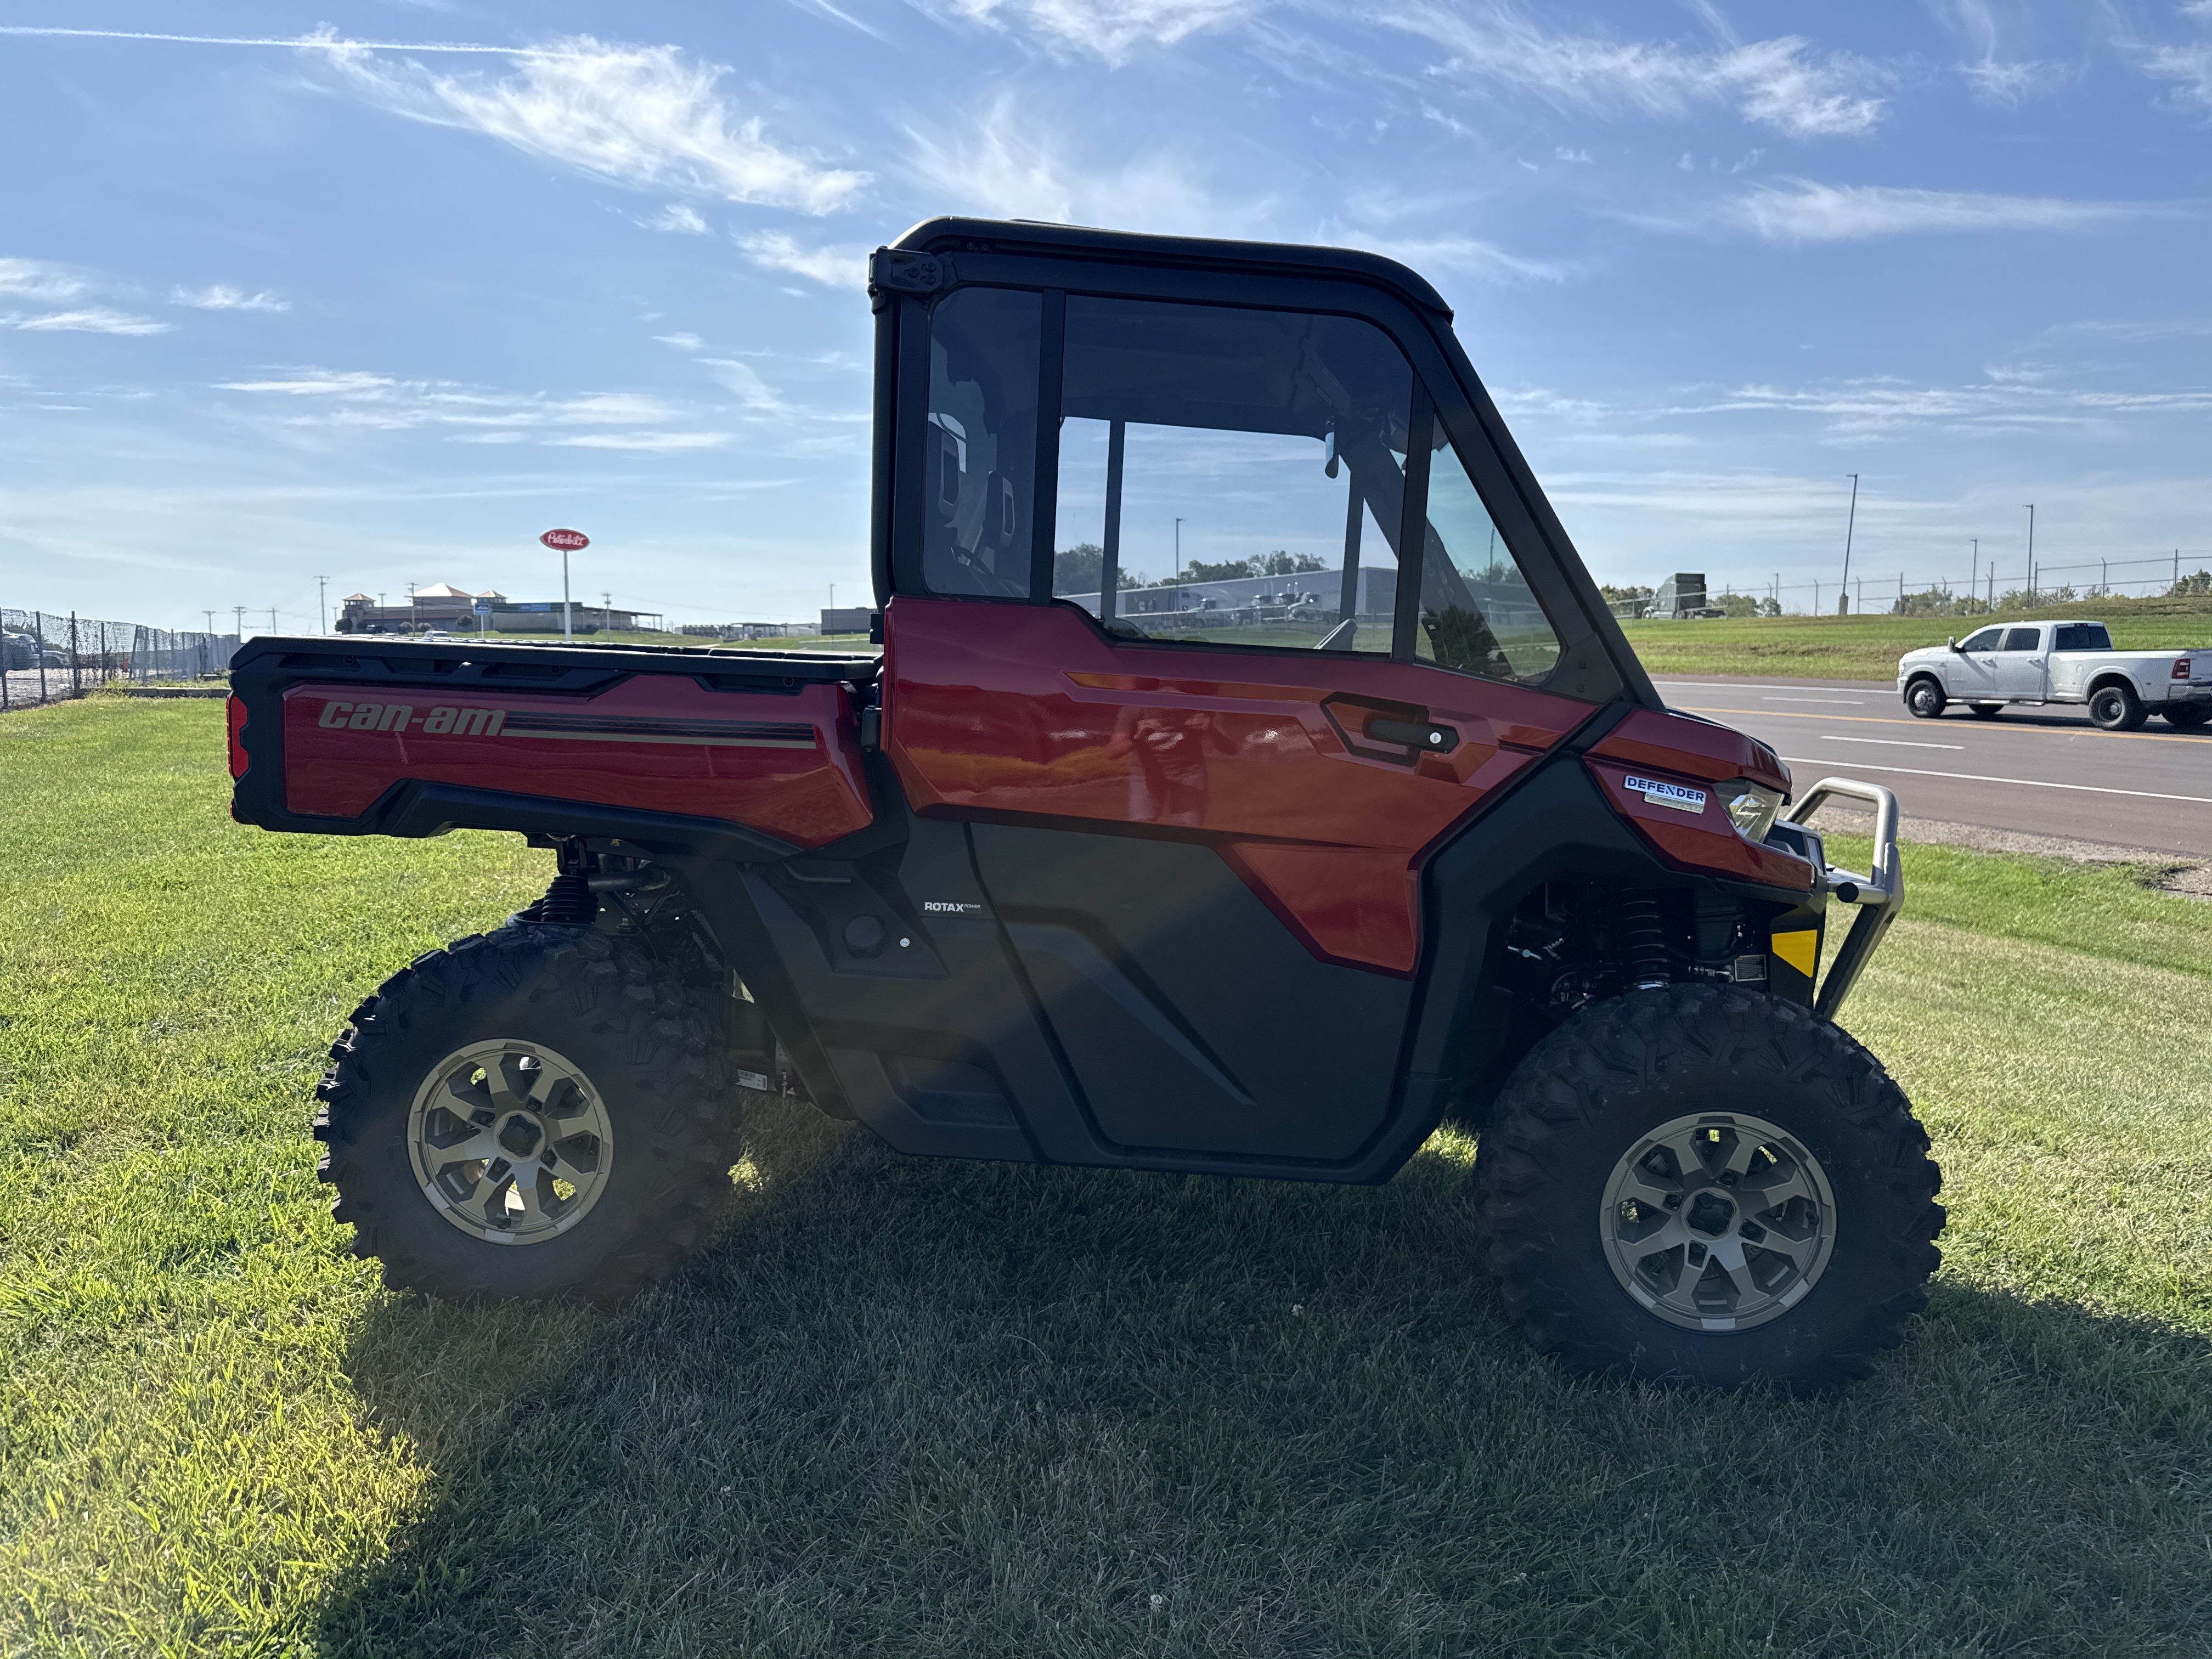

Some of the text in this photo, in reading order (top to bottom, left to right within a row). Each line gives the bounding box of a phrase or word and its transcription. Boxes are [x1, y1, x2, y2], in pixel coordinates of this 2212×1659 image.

[548, 532, 587, 546] Peterbilt
[1627, 777, 1705, 802] DEFENDER
[924, 901, 964, 912] ROTAX
